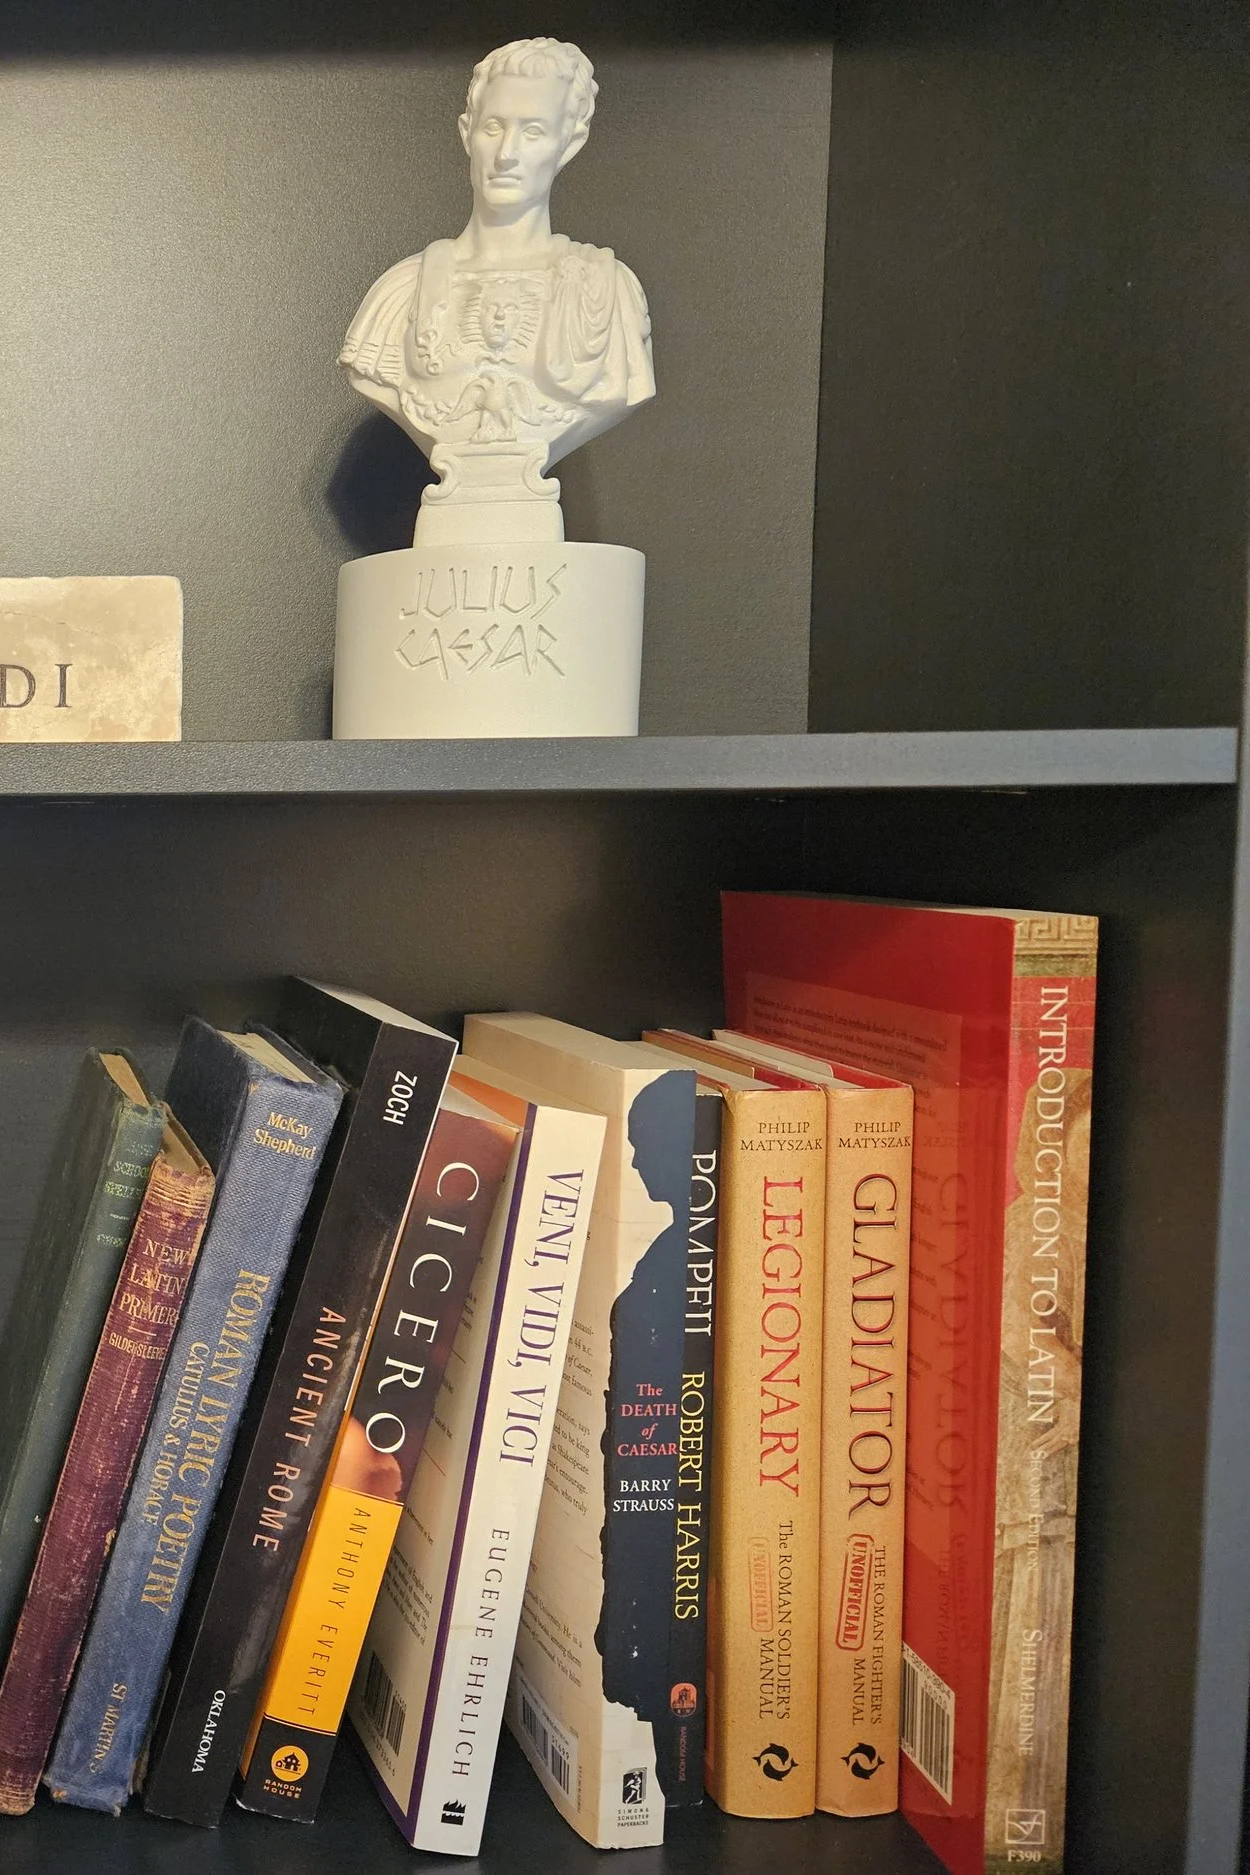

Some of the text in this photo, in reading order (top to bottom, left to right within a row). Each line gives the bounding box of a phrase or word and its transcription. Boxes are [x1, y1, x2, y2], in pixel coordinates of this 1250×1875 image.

[399, 563, 567, 620] JULIUS
[394, 624, 566, 680] CAESAR
[383, 1070, 419, 1125] ZOCH
[267, 1111, 313, 1139] McKay
[758, 1121, 811, 1135] PHILIP
[854, 1121, 902, 1134] PHILIP
[253, 1128, 318, 1161] Shepherd
[740, 1137, 824, 1152] MATYSZAK
[837, 1136, 912, 1150] MATYSZAK
[1026, 985, 1068, 1423] INTRODUCTION TO LATIN
[142, 1238, 189, 1265] NEW
[127, 1263, 186, 1296] LATIN
[118, 1291, 177, 1325] PRIMER
[366, 1161, 480, 1454] CICERO
[499, 1169, 584, 1467] VENI, VIDI, VICI
[759, 1176, 805, 1498] LEGIONARY
[848, 1173, 898, 1520] GLADIATOR
[636, 1384, 663, 1398] The
[674, 1149, 717, 1620] POMPEII ROBERT HARRIS
[620, 1402, 678, 1418] DEATH
[141, 1269, 270, 1615] ROMAN LYRIC POETRY
[164, 1433, 182, 1447] &
[252, 1307, 347, 1553] ANCIENT ROME
[641, 1423, 658, 1440] of
[616, 1442, 678, 1458] CAESAR
[619, 1478, 672, 1494] BARRY
[612, 1497, 675, 1513] STRAUSS
[843, 1540, 866, 1643] UNOFFICIAL
[298, 1508, 371, 1716] ANTHONY EVERITT
[776, 1520, 794, 1720] The ROMAN SOLDIER'S
[870, 1545, 887, 1725] THE ROMAN FIGHTER'S
[452, 1528, 510, 1778] EUGENE EHRLICH
[759, 1637, 775, 1719] MANUAL
[852, 1657, 867, 1725] MANUAL
[191, 1689, 227, 1774] OKLAHOMA
[263, 1785, 300, 1799] HOUSE
[265, 1779, 302, 1793] RANDOM
[617, 1820, 649, 1828] PAPERBACKS
[1007, 1850, 1042, 1863] F390
